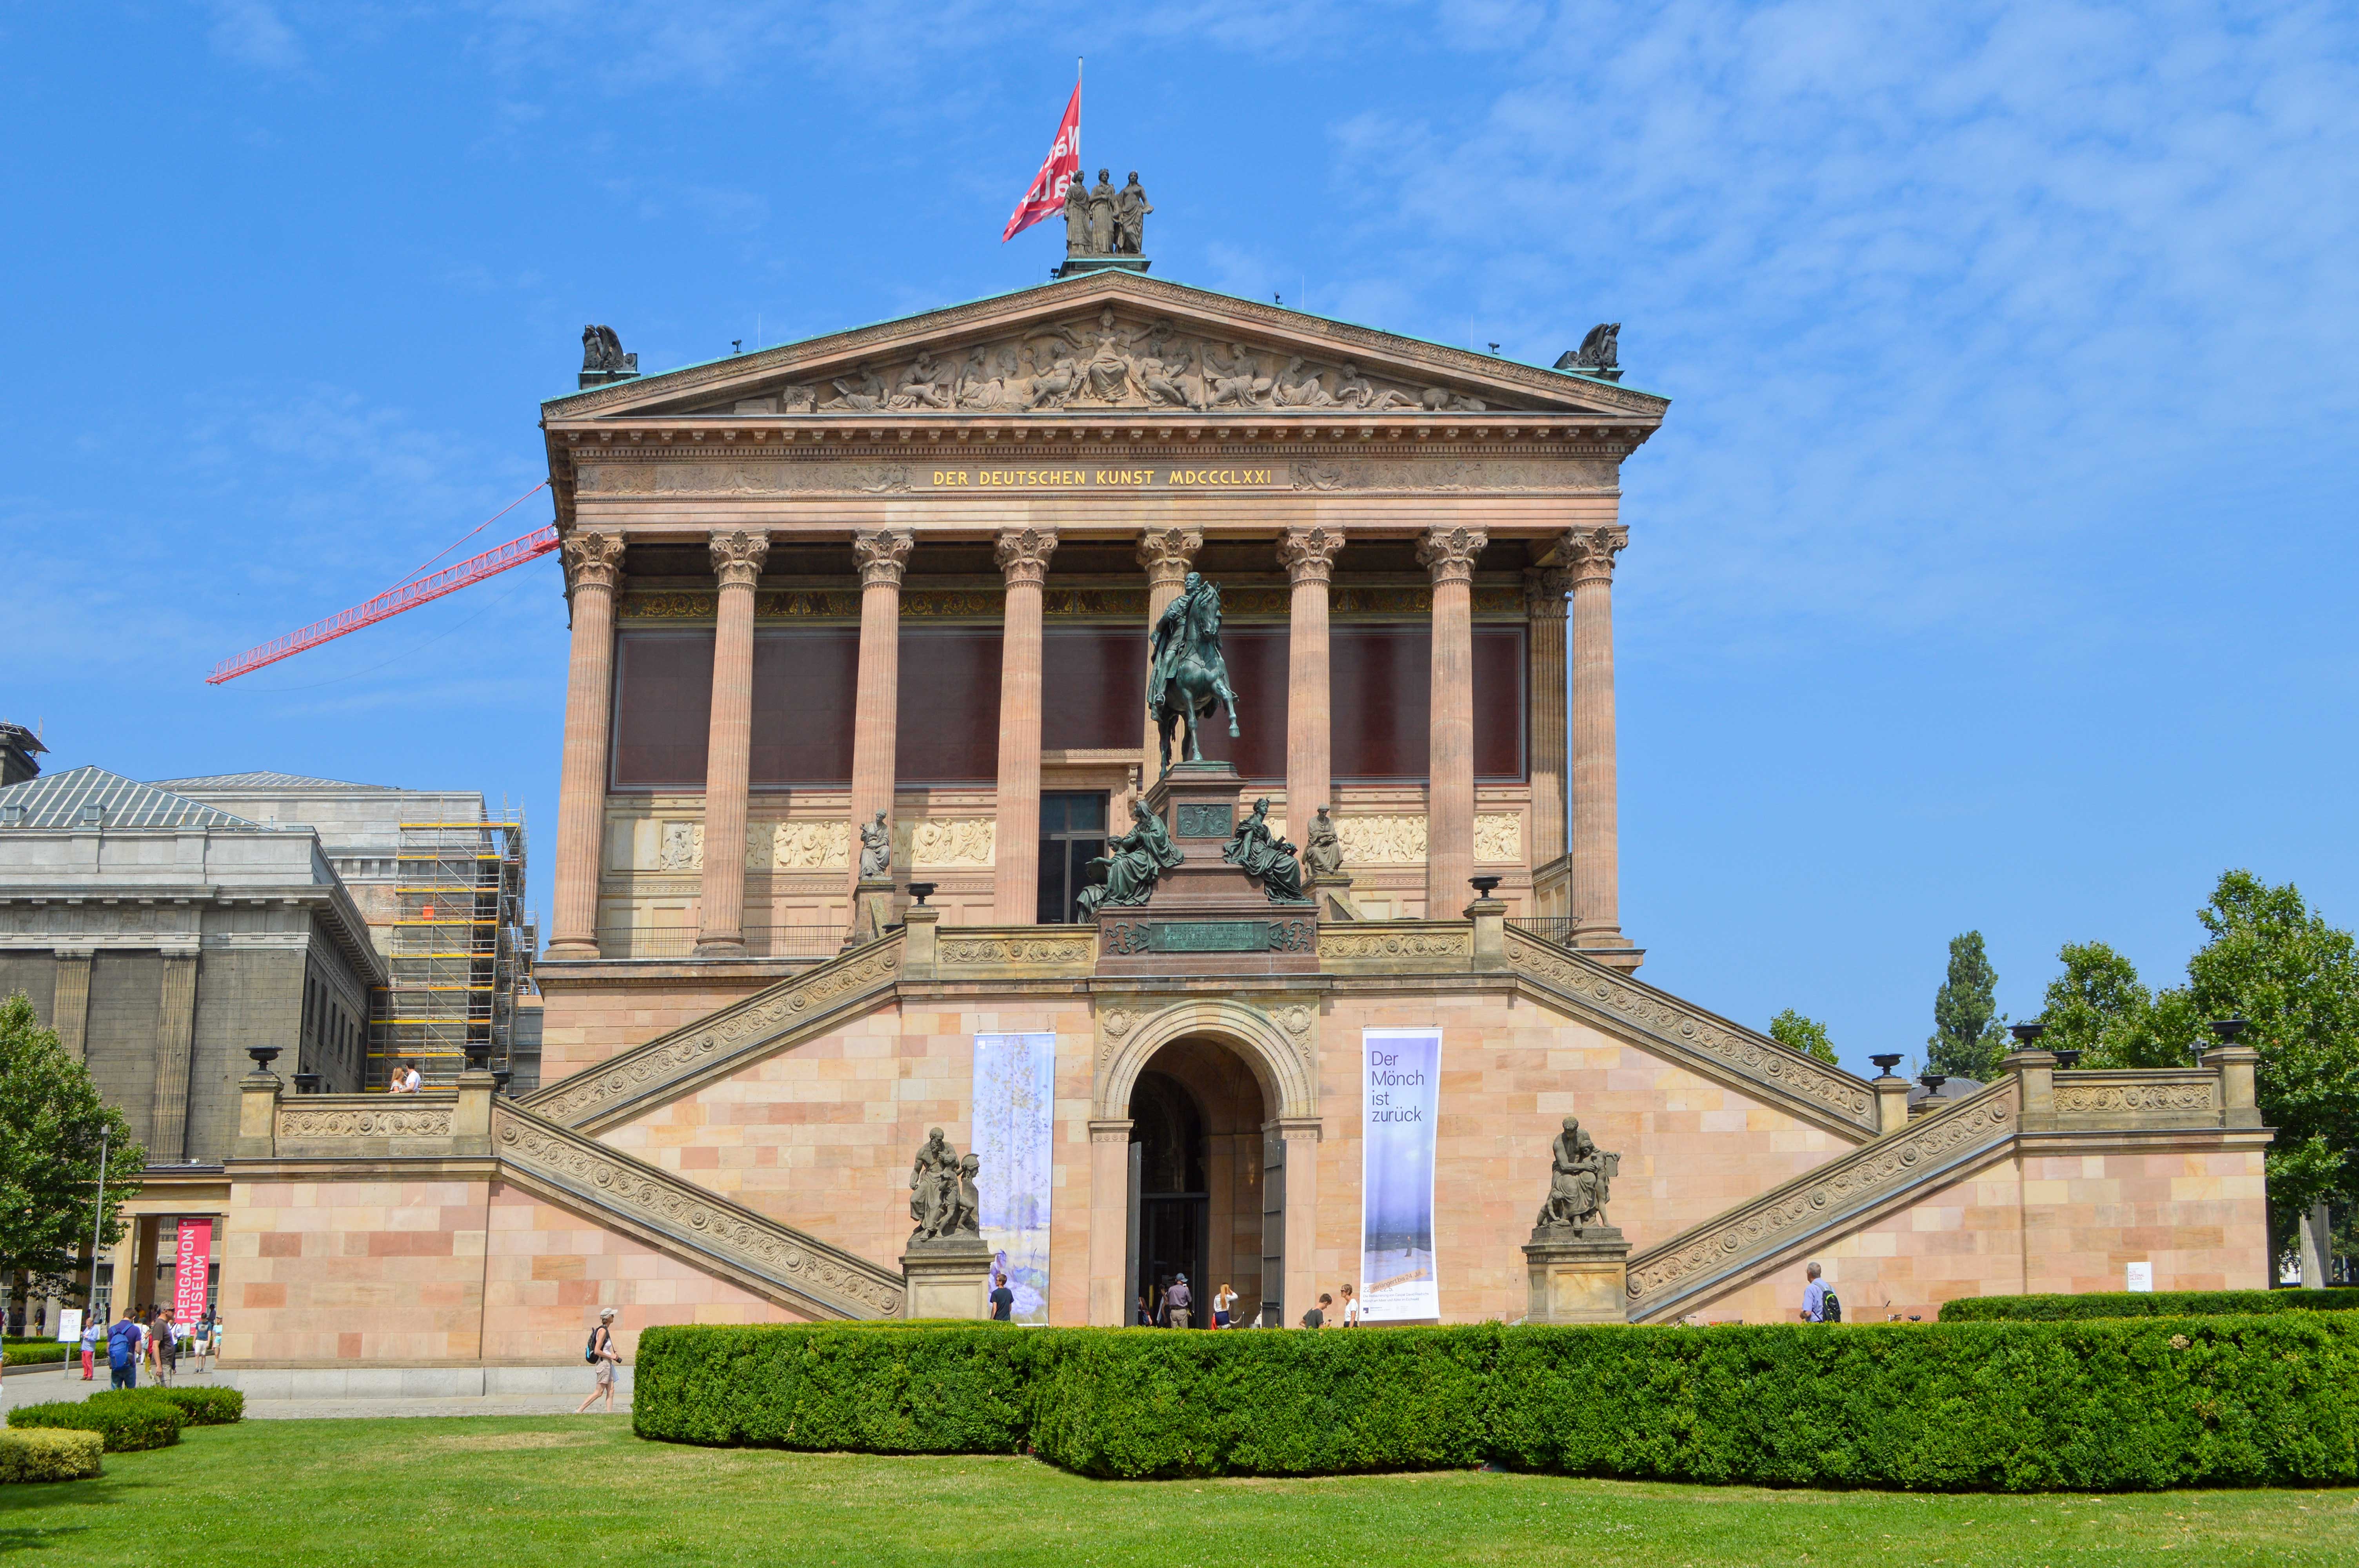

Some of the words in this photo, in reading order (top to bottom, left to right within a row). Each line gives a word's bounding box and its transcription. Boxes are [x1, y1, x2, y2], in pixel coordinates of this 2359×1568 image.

[934, 471, 969, 485] DER
[980, 471, 1085, 485] DEUTSCHEN
[1096, 471, 1154, 485] KUNST
[1169, 470, 1271, 485] MDCCCLXXI
[1372, 1051, 1399, 1066] Der
[1372, 1069, 1424, 1086] Mönch
[1372, 1090, 1389, 1106] ist
[1372, 1105, 1422, 1122] zurück
[177, 1229, 194, 1319] PERGAMON
[190, 1255, 206, 1327] MUSEUM
